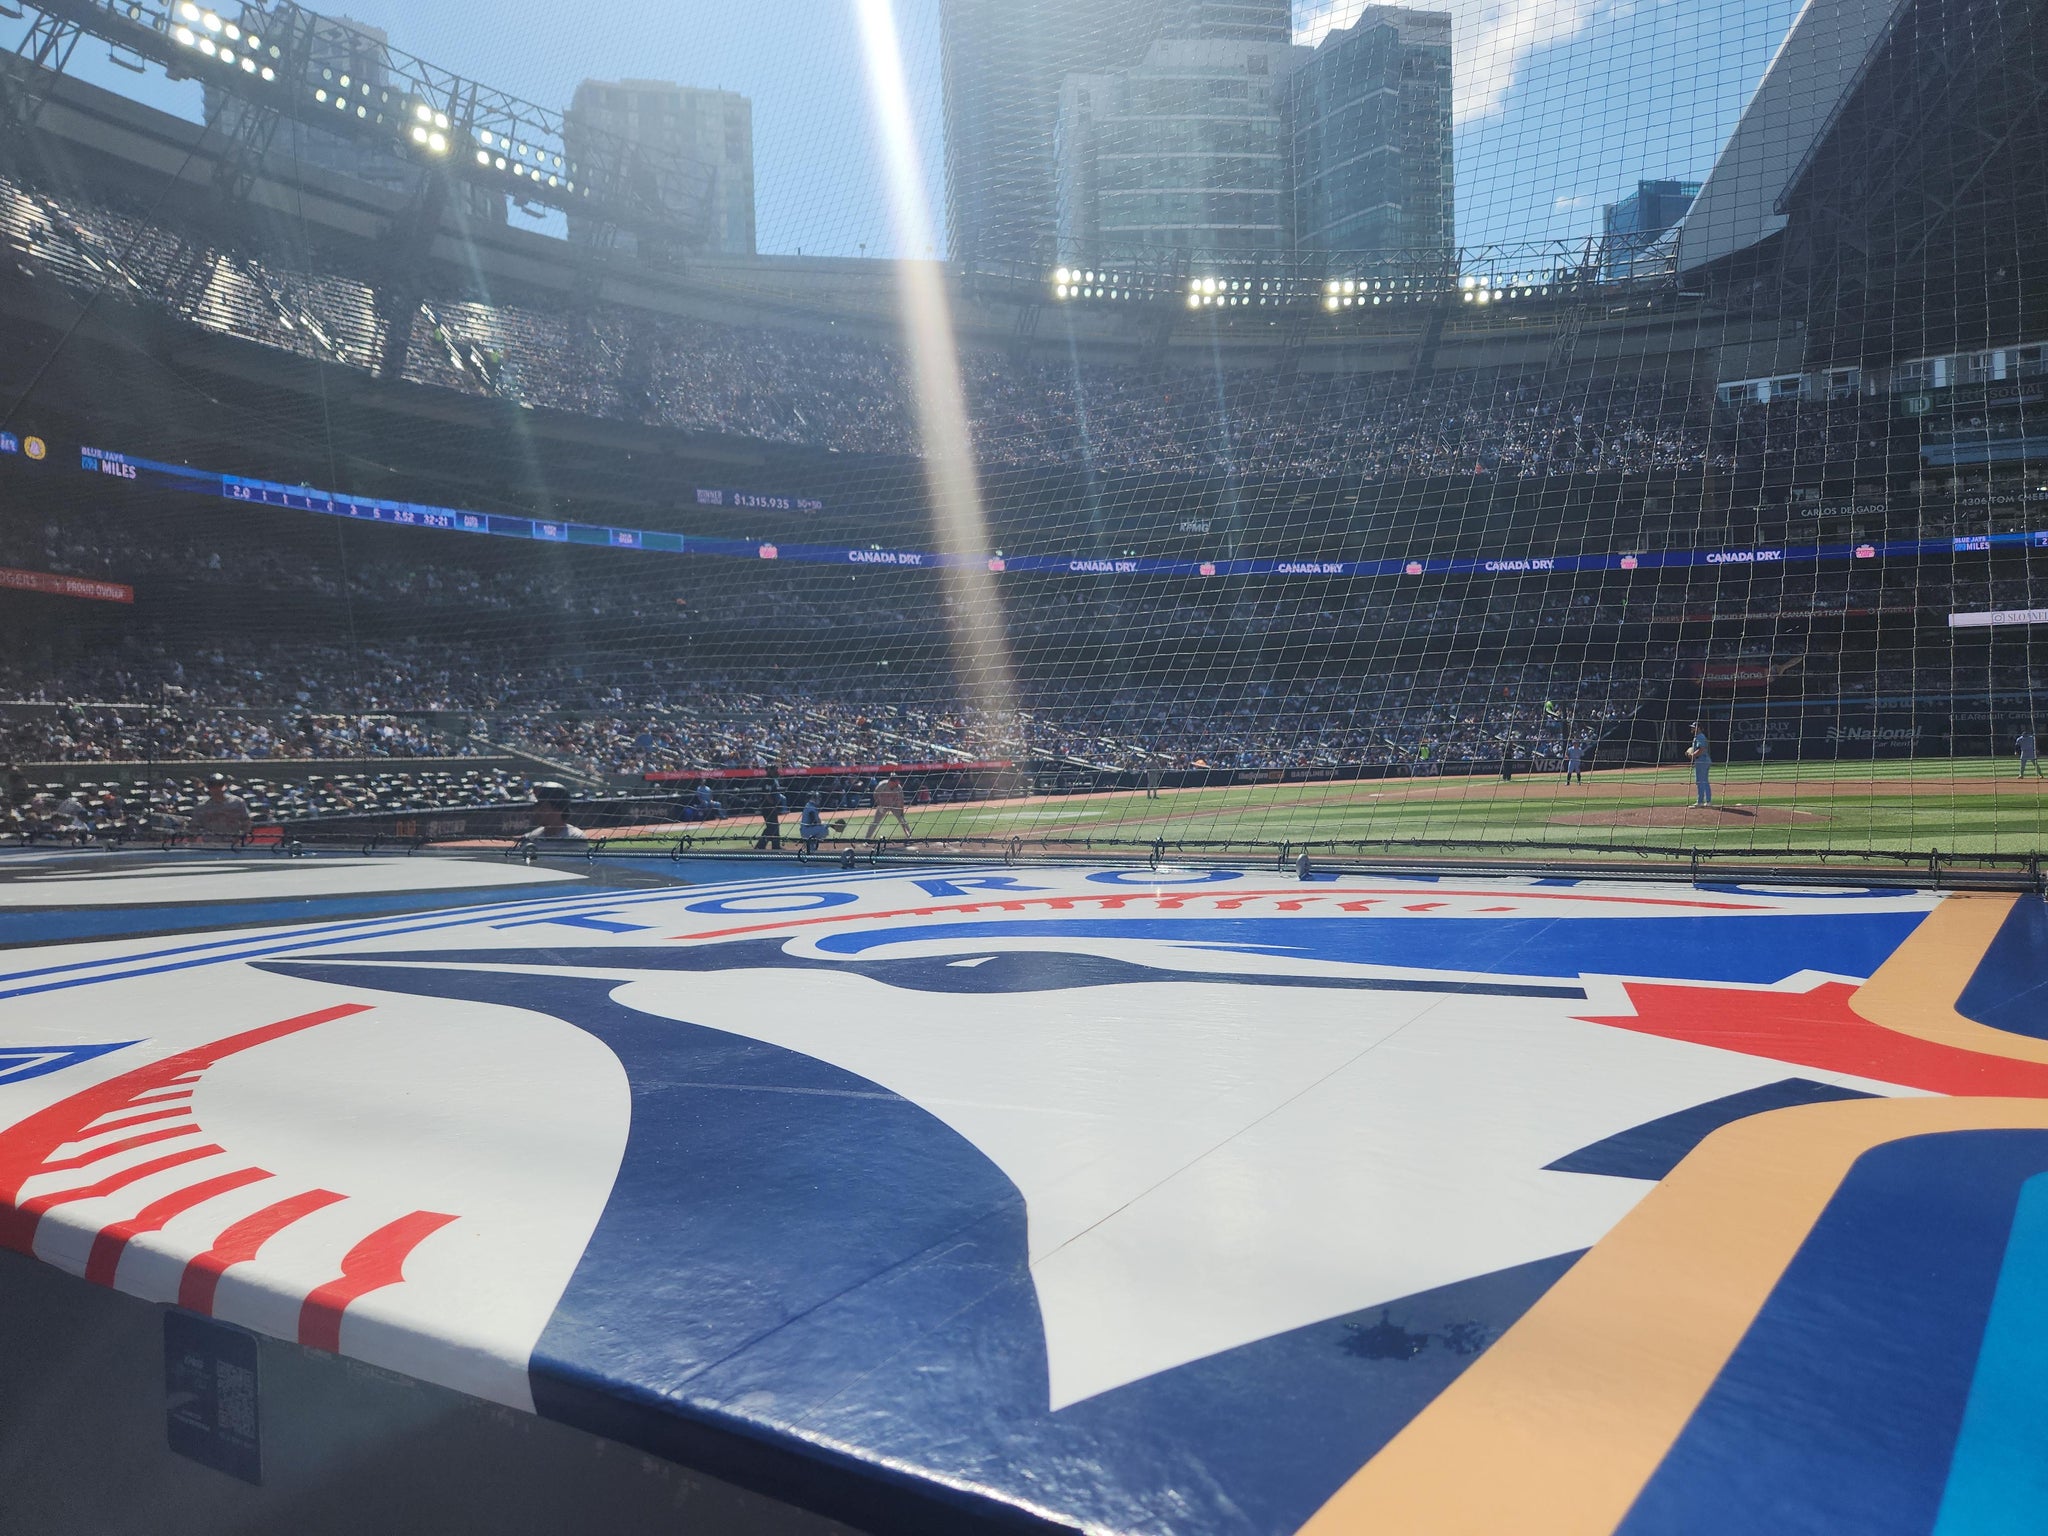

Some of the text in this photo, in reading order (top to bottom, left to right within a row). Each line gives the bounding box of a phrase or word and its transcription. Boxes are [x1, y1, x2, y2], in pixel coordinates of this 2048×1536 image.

[1989, 384, 2044, 398] SOCIAL
[1904, 397, 1931, 412] TD
[102, 459, 136, 479] MILES
[1962, 497, 1988, 506] 4306
[1990, 495, 2014, 504] TOM
[1801, 504, 1885, 517] CARLOS DELGADO
[1179, 522, 1210, 533] KPMG
[1966, 541, 1990, 551] MILES
[849, 551, 896, 563] CANADA
[1706, 551, 1753, 563] CANADA
[1070, 561, 1114, 572] CANADA
[1278, 563, 1321, 573] CANADA
[1485, 560, 1530, 571] CANADA
[1738, 720, 1790, 733] CLEARLY
[1848, 725, 1923, 739] National
[1874, 739, 1919, 748] Car Rental
[1535, 760, 1566, 772] VISA
